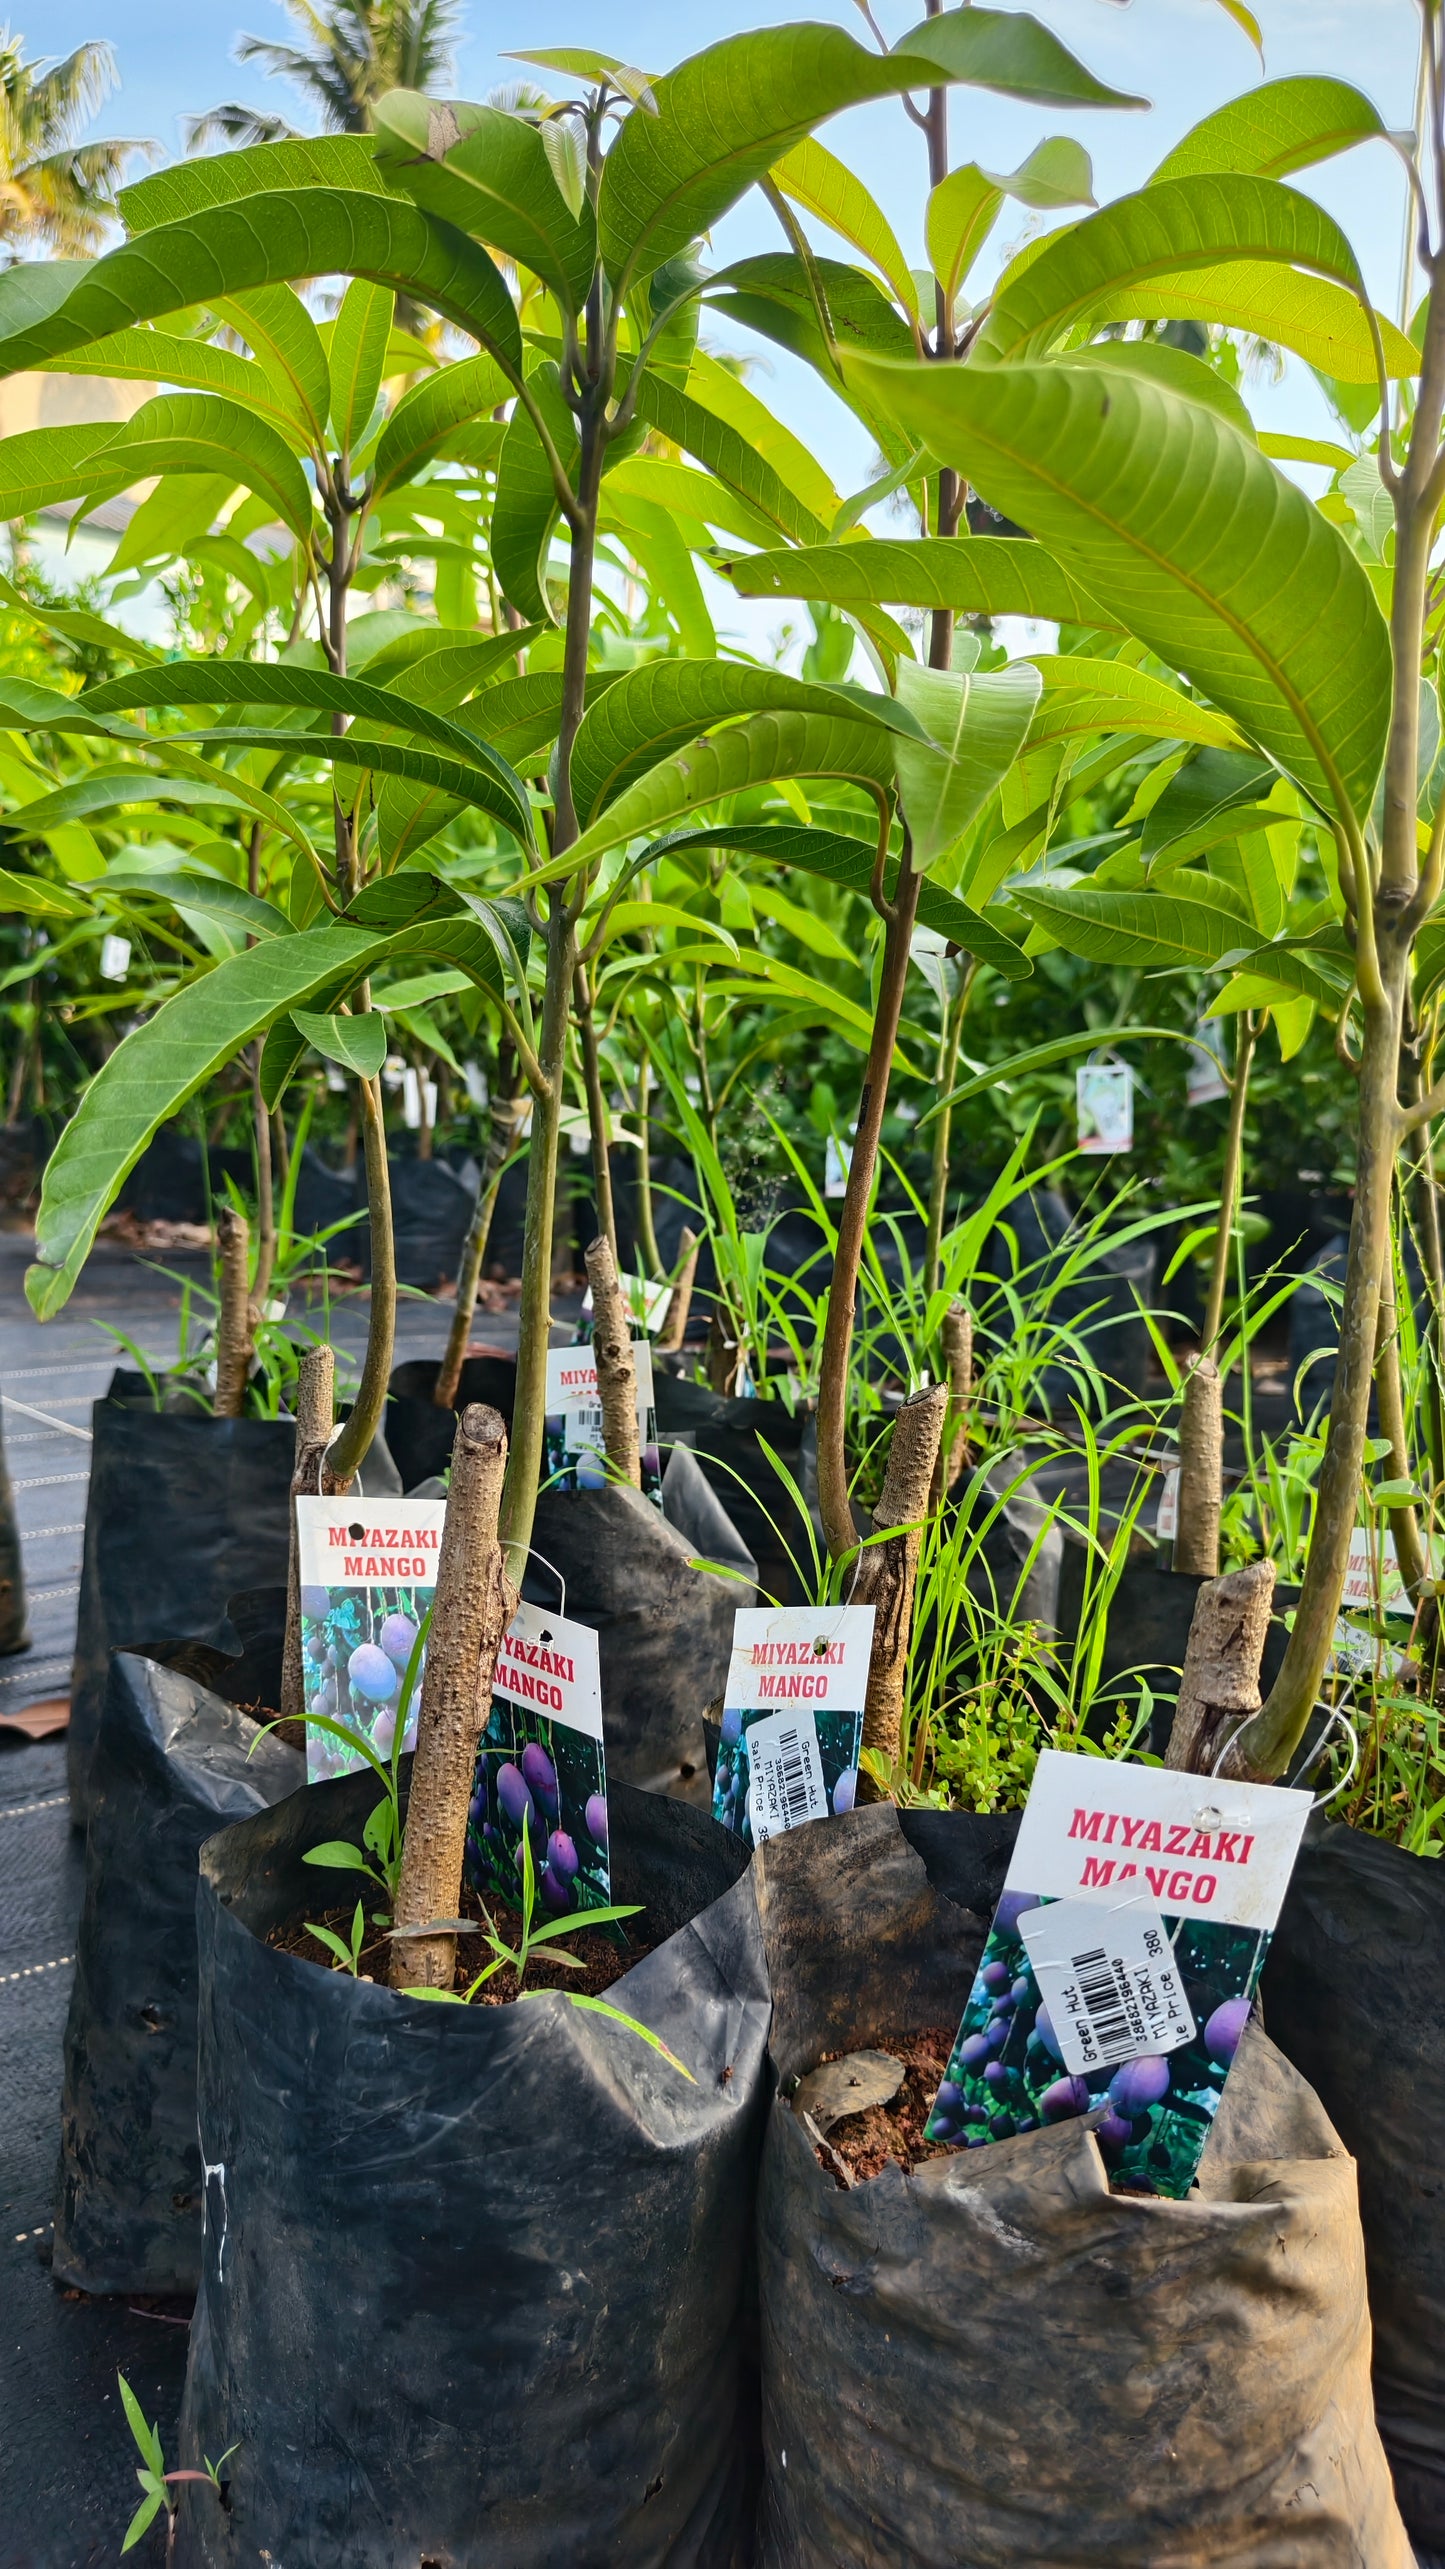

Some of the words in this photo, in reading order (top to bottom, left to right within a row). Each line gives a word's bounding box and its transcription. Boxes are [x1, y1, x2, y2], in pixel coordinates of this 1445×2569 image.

[560, 1369, 599, 1386] MIYA
[344, 1556, 426, 1577] MANGO
[500, 1633, 575, 1683] YAZAKI
[493, 1663, 563, 1711] MANGO
[758, 1675, 828, 1698] MANGO
[751, 1740, 761, 1770] Sale
[758, 1825, 769, 1840] 38
[764, 1760, 779, 1819] MIYAZAKI
[774, 1758, 791, 1830] 38682196440
[801, 1740, 813, 1780] Green
[807, 1784, 819, 1809] Hut
[1067, 1808, 1255, 1865] MIYAZAKI
[1143, 1929, 1163, 1958] 380
[1061, 1985, 1082, 2014] Hut
[1111, 1957, 1148, 2042] 38682196440
[1133, 1968, 1168, 2040] MIYAZAKI
[1075, 2018, 1098, 2063] Green
